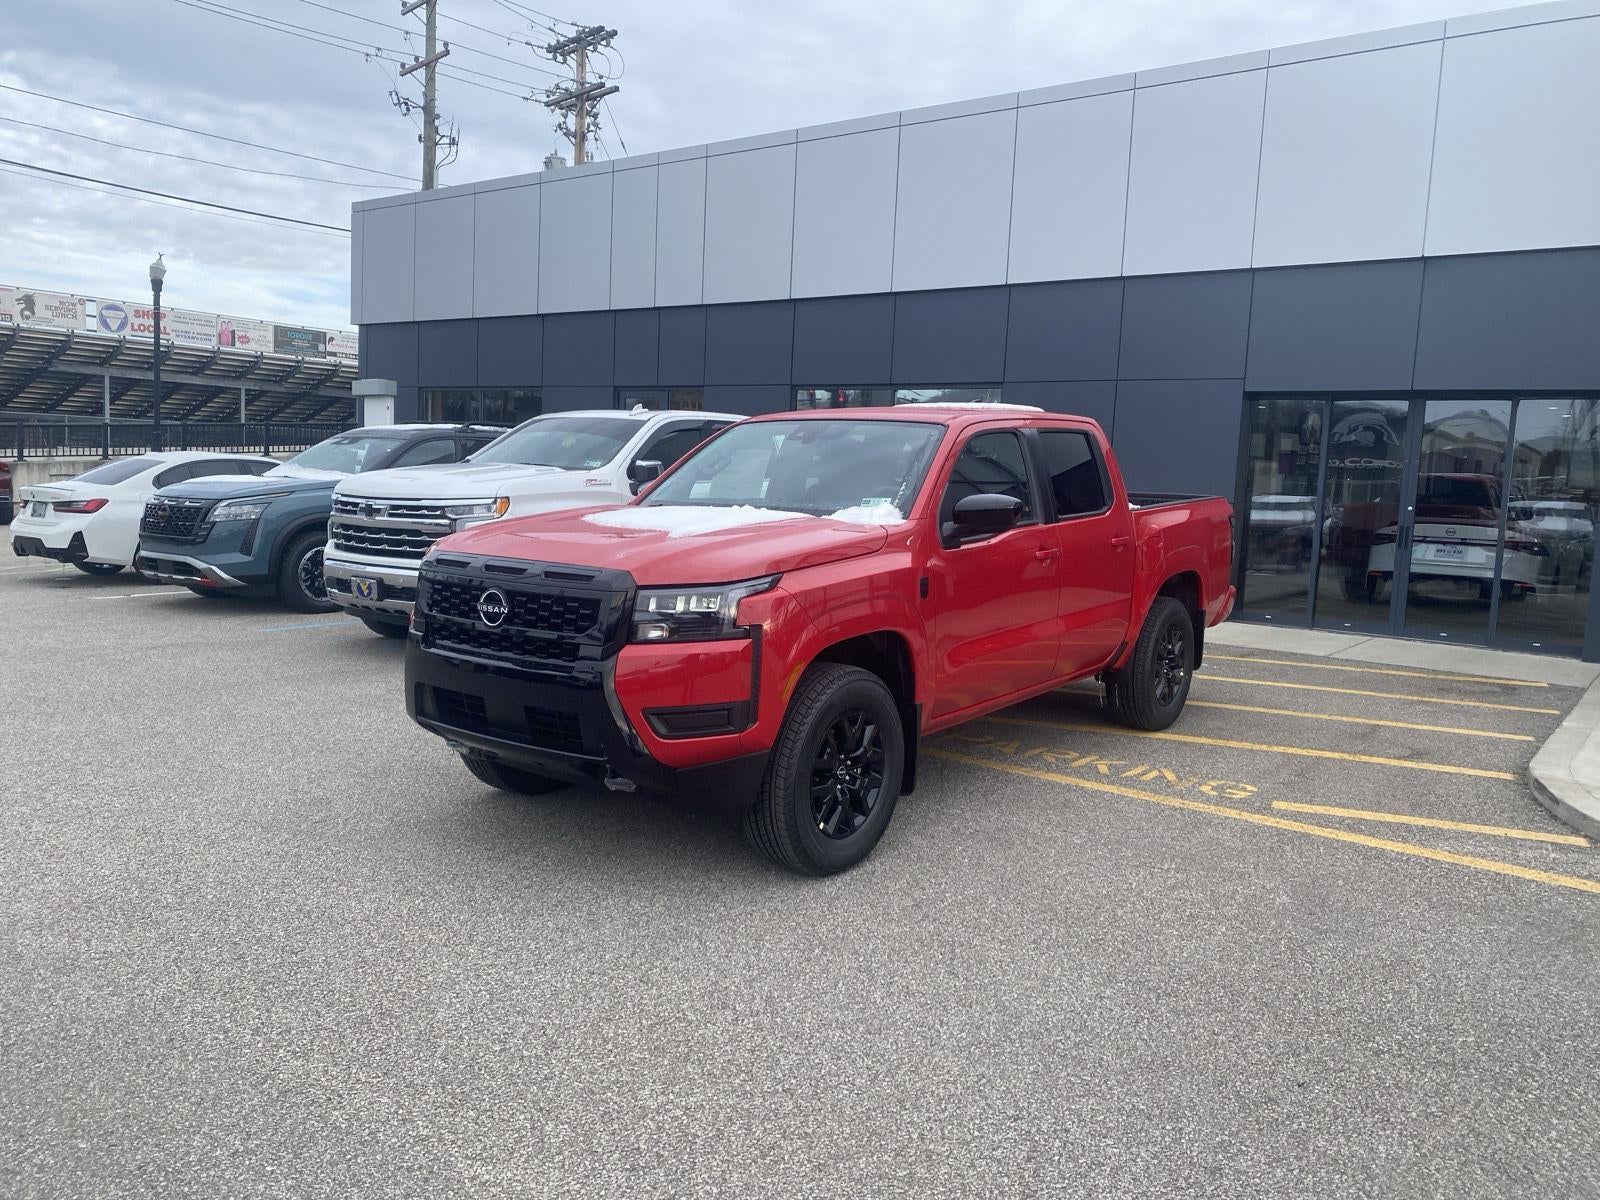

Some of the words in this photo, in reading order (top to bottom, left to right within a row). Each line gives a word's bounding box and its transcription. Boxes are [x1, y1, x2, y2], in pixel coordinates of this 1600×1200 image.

[58, 300, 78, 308] NOW
[44, 304, 78, 314] SERVING
[51, 311, 78, 320] LUNCH
[133, 308, 167, 322] SHOP
